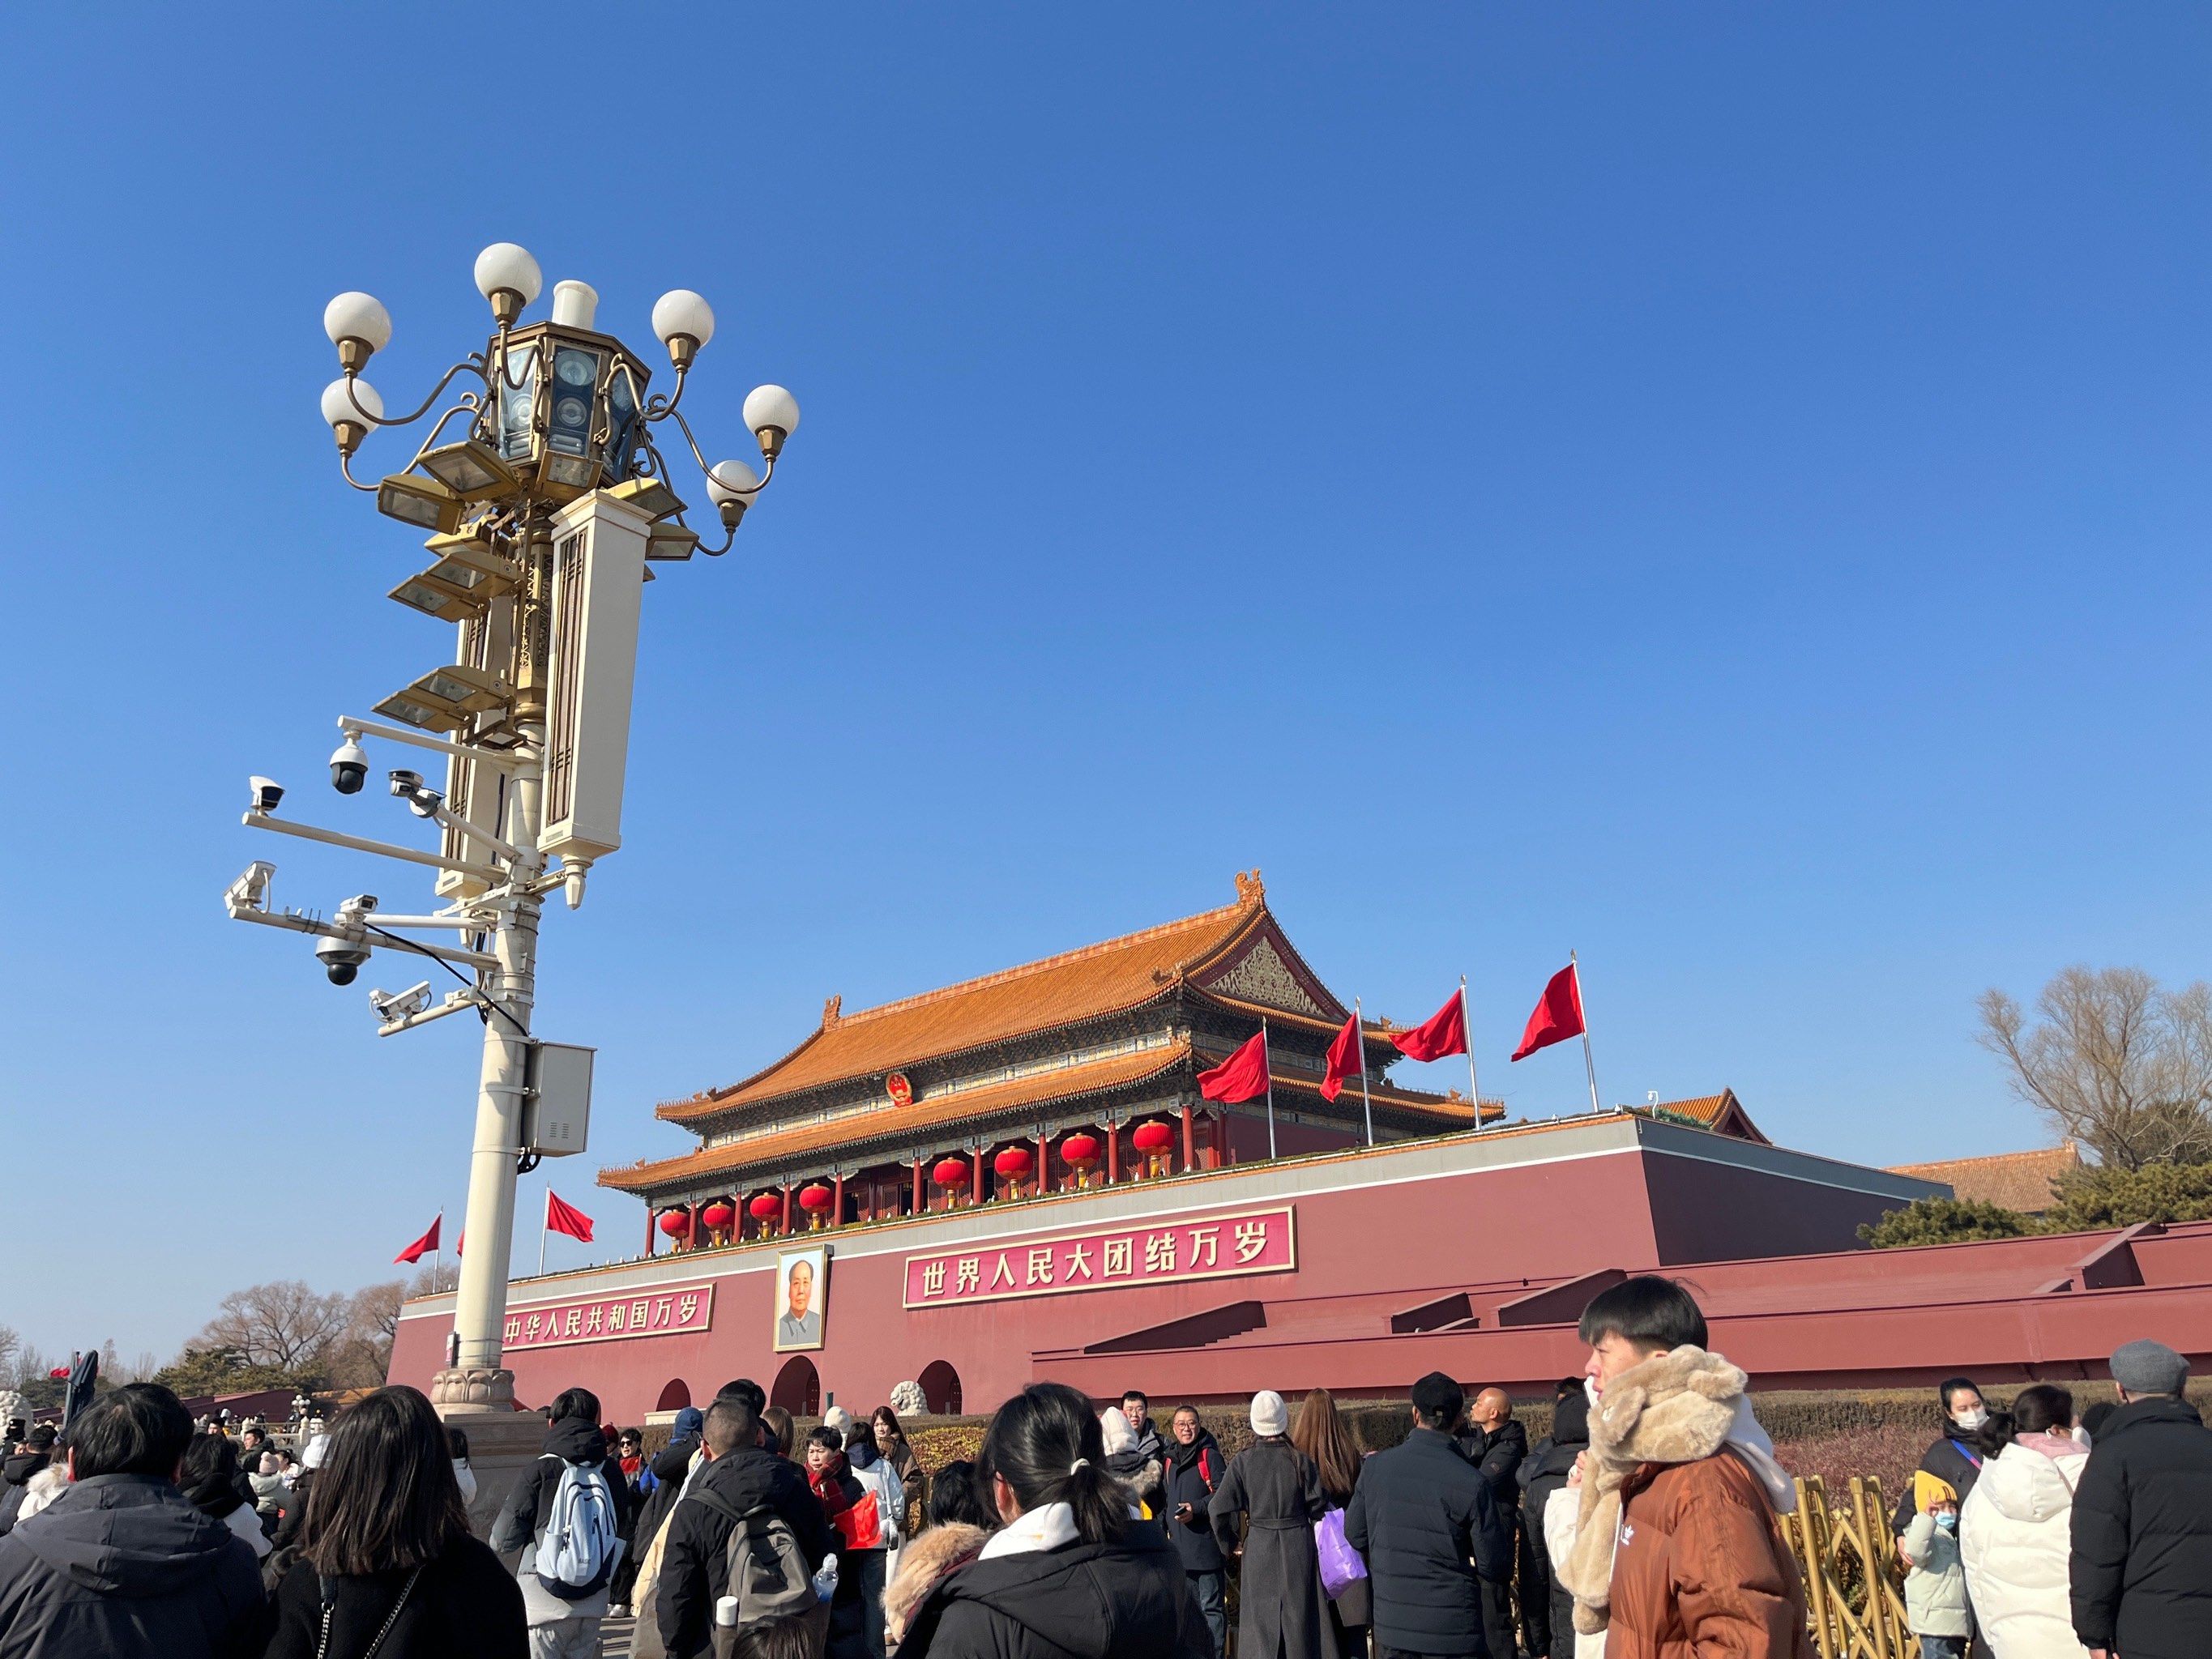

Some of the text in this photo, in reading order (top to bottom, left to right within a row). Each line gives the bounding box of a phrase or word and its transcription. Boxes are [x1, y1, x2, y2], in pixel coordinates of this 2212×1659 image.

[922, 1222, 1267, 1297] 世界人民大团结万岁
[505, 1294, 699, 1343] 中华人民共和国万岁
